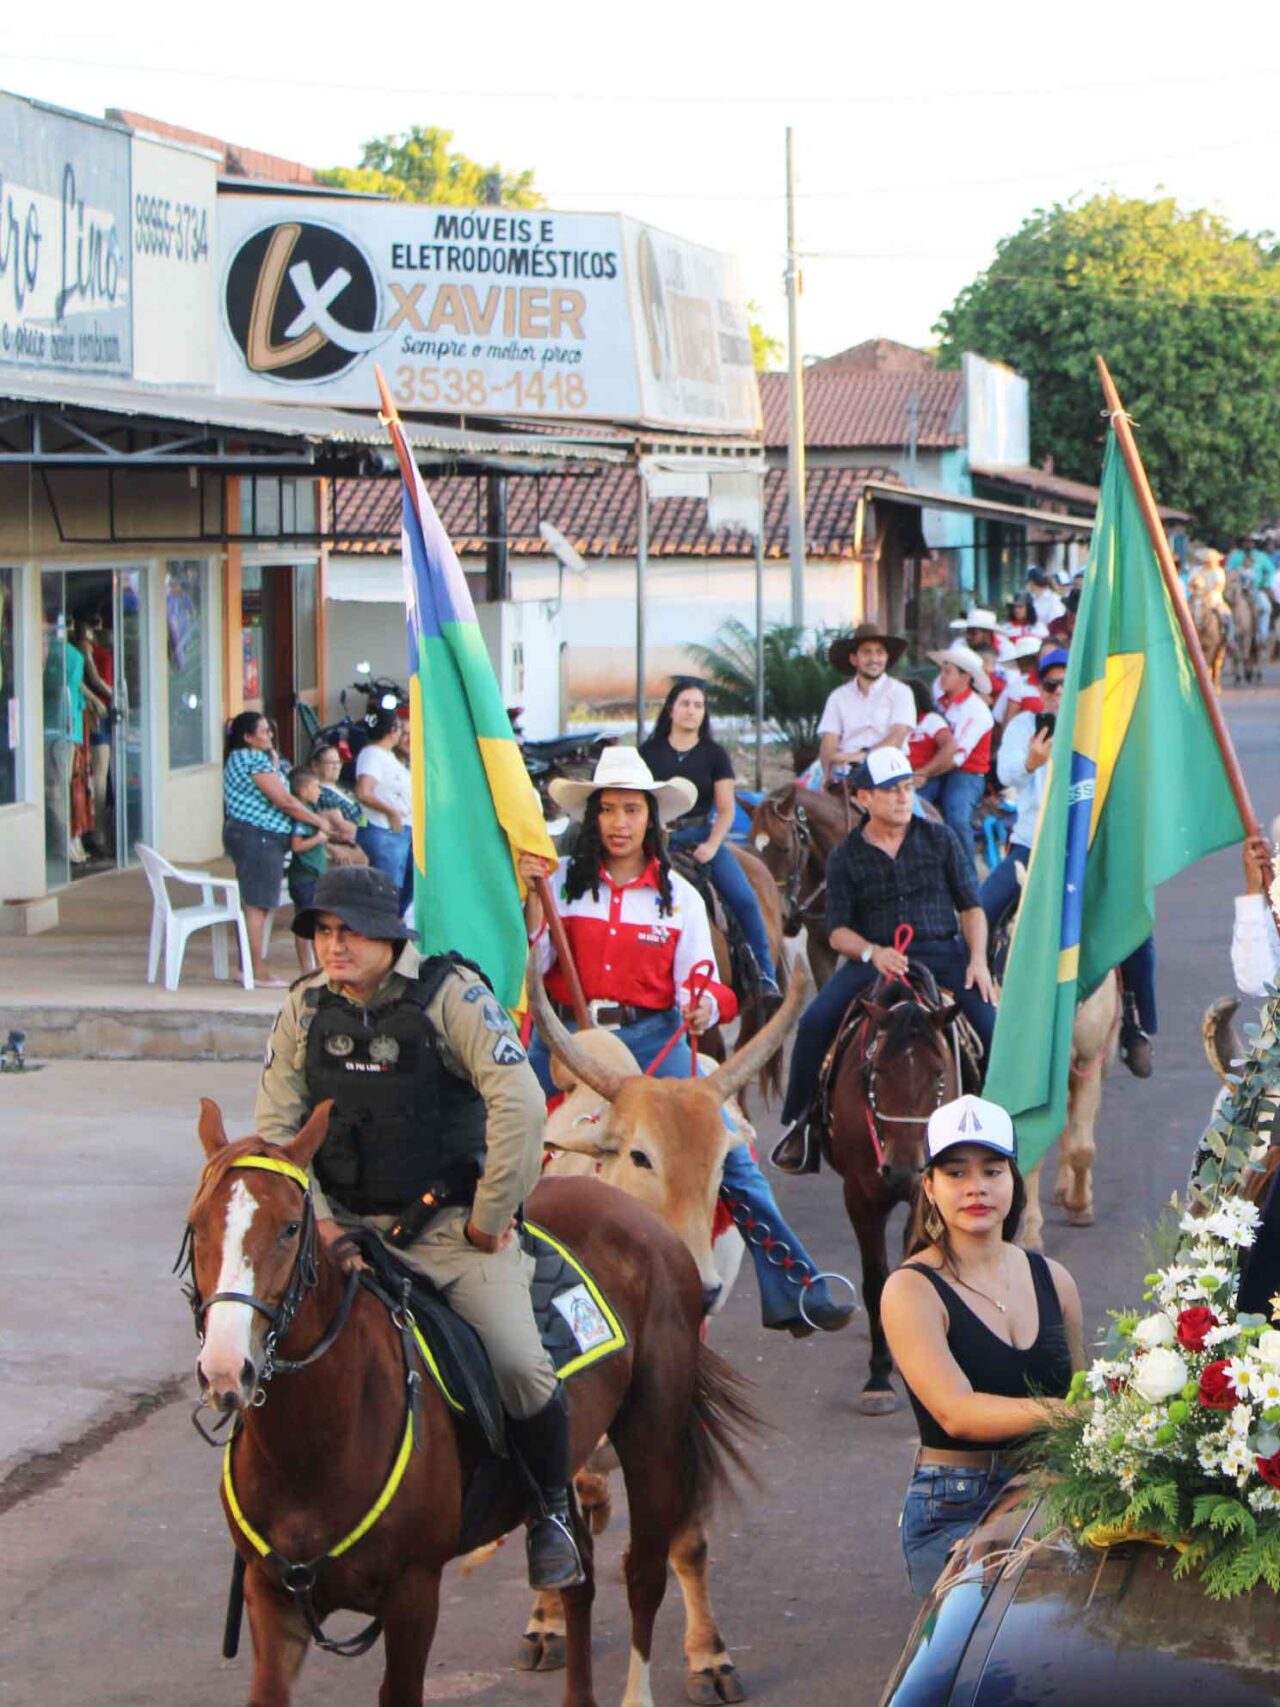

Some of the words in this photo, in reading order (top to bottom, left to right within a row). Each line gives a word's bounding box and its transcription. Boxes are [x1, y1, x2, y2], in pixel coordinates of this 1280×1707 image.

[434, 212, 532, 243] MÓVEIS
[540, 220, 554, 242] E
[391, 242, 618, 280] ELETRODOMÉSTICOS
[386, 282, 587, 340] XAVIER
[401, 336, 467, 361] Sempre
[471, 345, 482, 353] o
[486, 340, 536, 362] melhor
[542, 347, 583, 370] preço
[394, 365, 588, 410] 3538-1418
